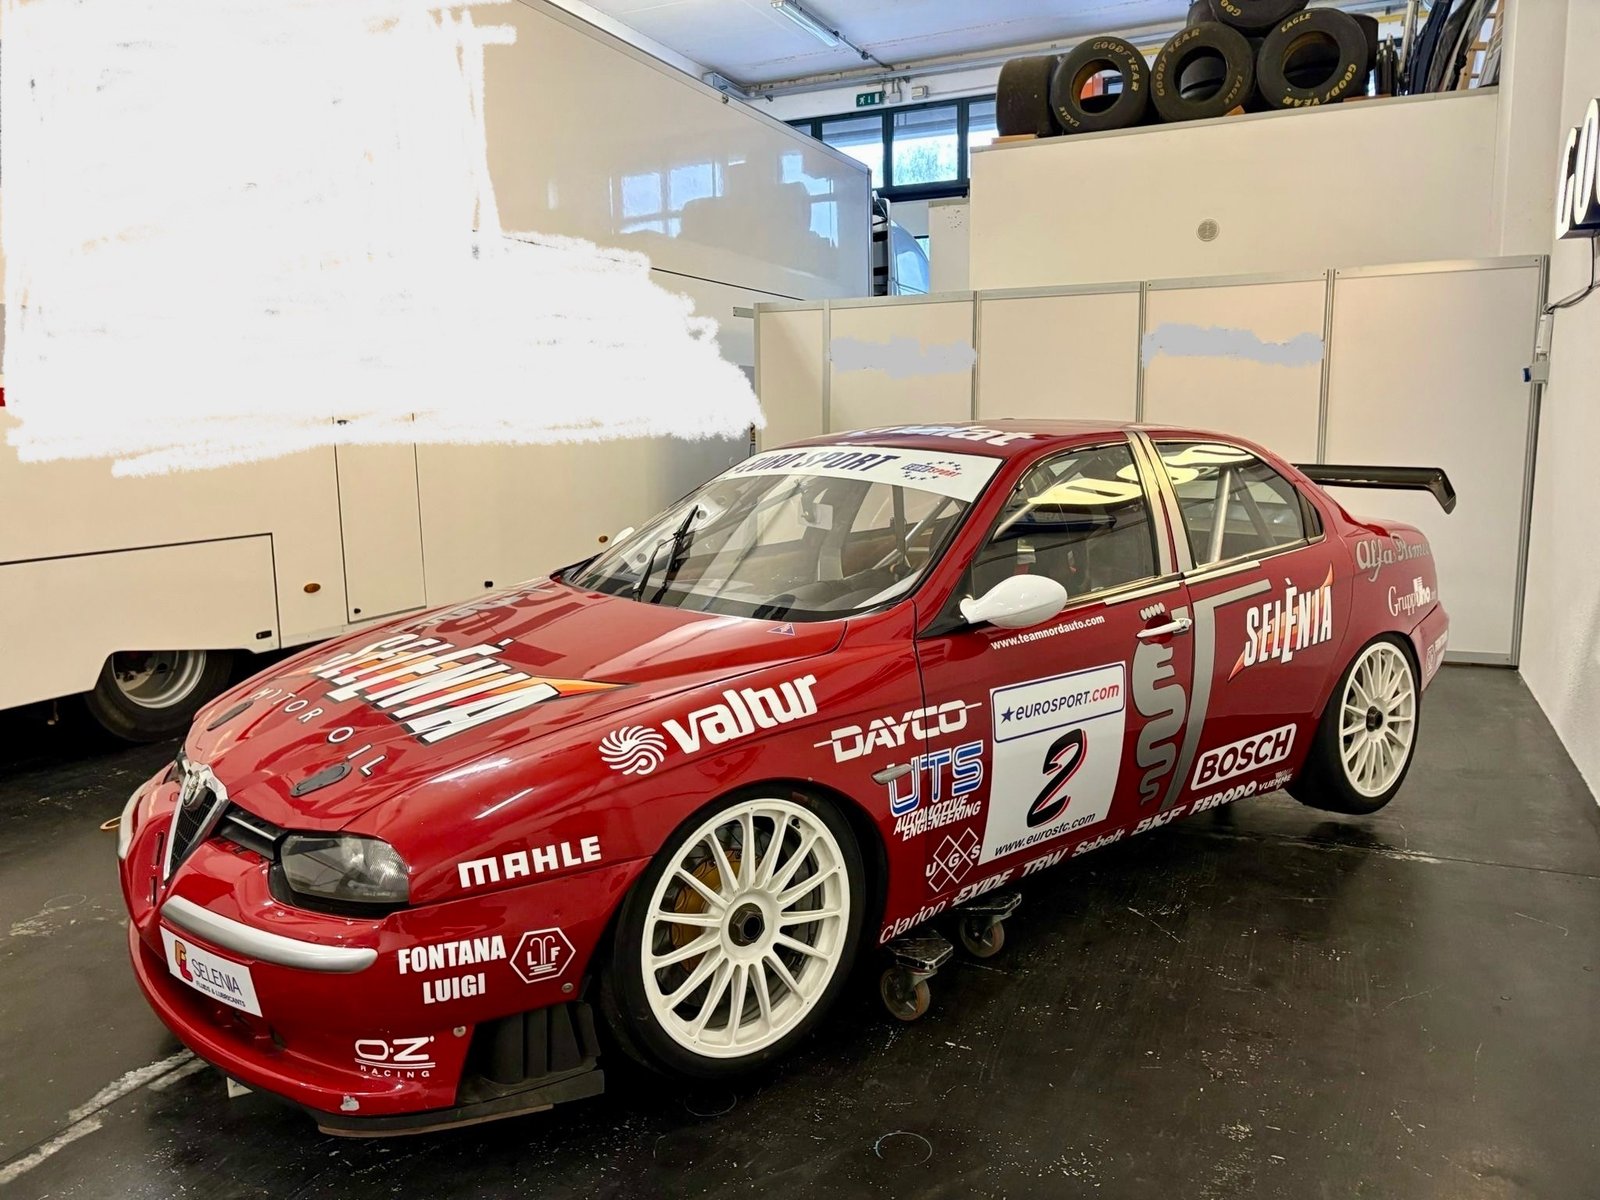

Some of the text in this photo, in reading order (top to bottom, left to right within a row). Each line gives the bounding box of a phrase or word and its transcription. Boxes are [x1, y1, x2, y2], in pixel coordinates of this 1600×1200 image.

[1281, 13, 1312, 32] EAGLE
[792, 451, 900, 471] SPORT
[991, 615, 1105, 650] www.teamnordauto.com
[662, 674, 817, 754] valtur
[831, 700, 967, 763] DAYCO
[325, 726, 388, 776] OIL
[1200, 729, 1288, 779] BOSCH
[887, 740, 984, 818] UTS
[1027, 728, 1088, 828] 2
[893, 795, 969, 835] AUTOMOTIVE
[902, 801, 981, 841] ENGINEERING
[994, 812, 1096, 857] www.eurostc.com
[457, 835, 602, 888] MAHLE
[952, 868, 1014, 906] EXIDE
[1188, 780, 1257, 815] FERODO
[398, 935, 507, 974] FONTANA
[191, 958, 242, 996] SELENIA
[422, 973, 486, 1004] LUIGI
[360, 1065, 430, 1078] RACING
